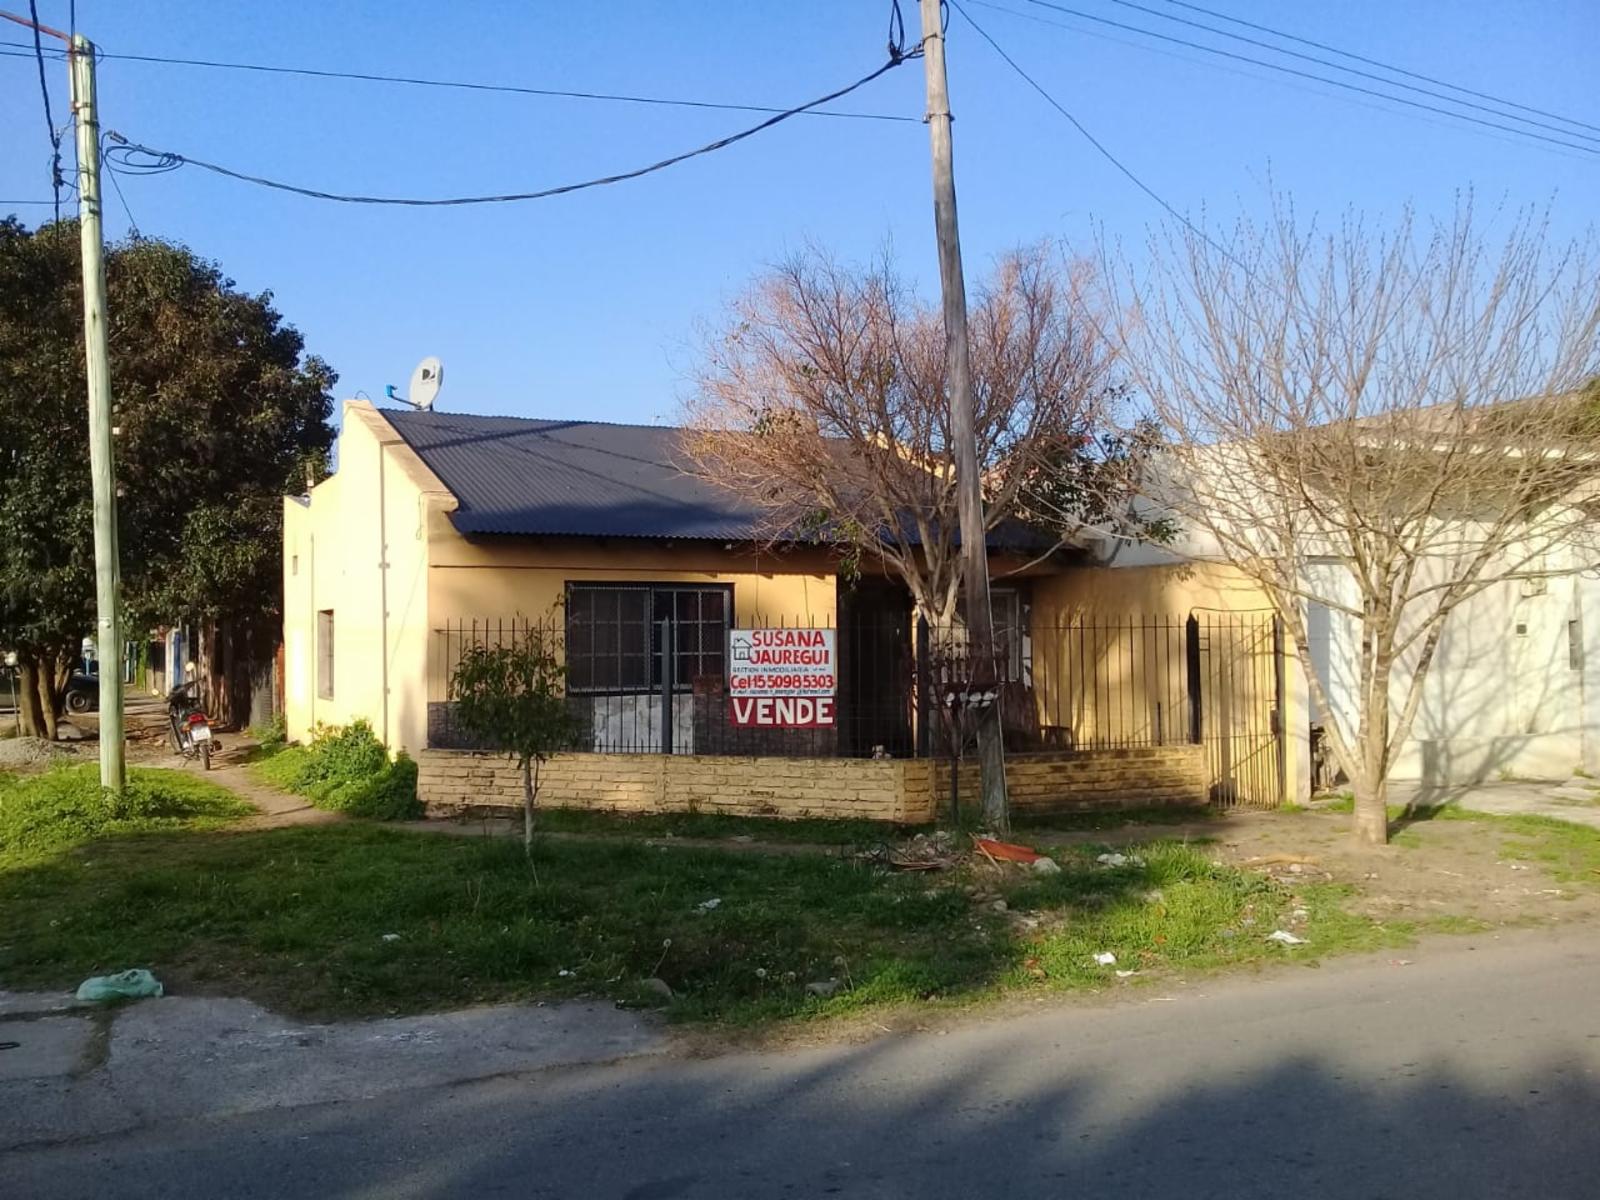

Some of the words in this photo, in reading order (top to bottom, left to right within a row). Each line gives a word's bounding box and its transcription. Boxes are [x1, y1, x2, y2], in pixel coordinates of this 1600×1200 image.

[752, 631, 825, 647] SUSANA
[749, 650, 829, 665] JAUREGUI
[803, 675, 833, 688] 5303
[733, 698, 833, 724] VENDE
